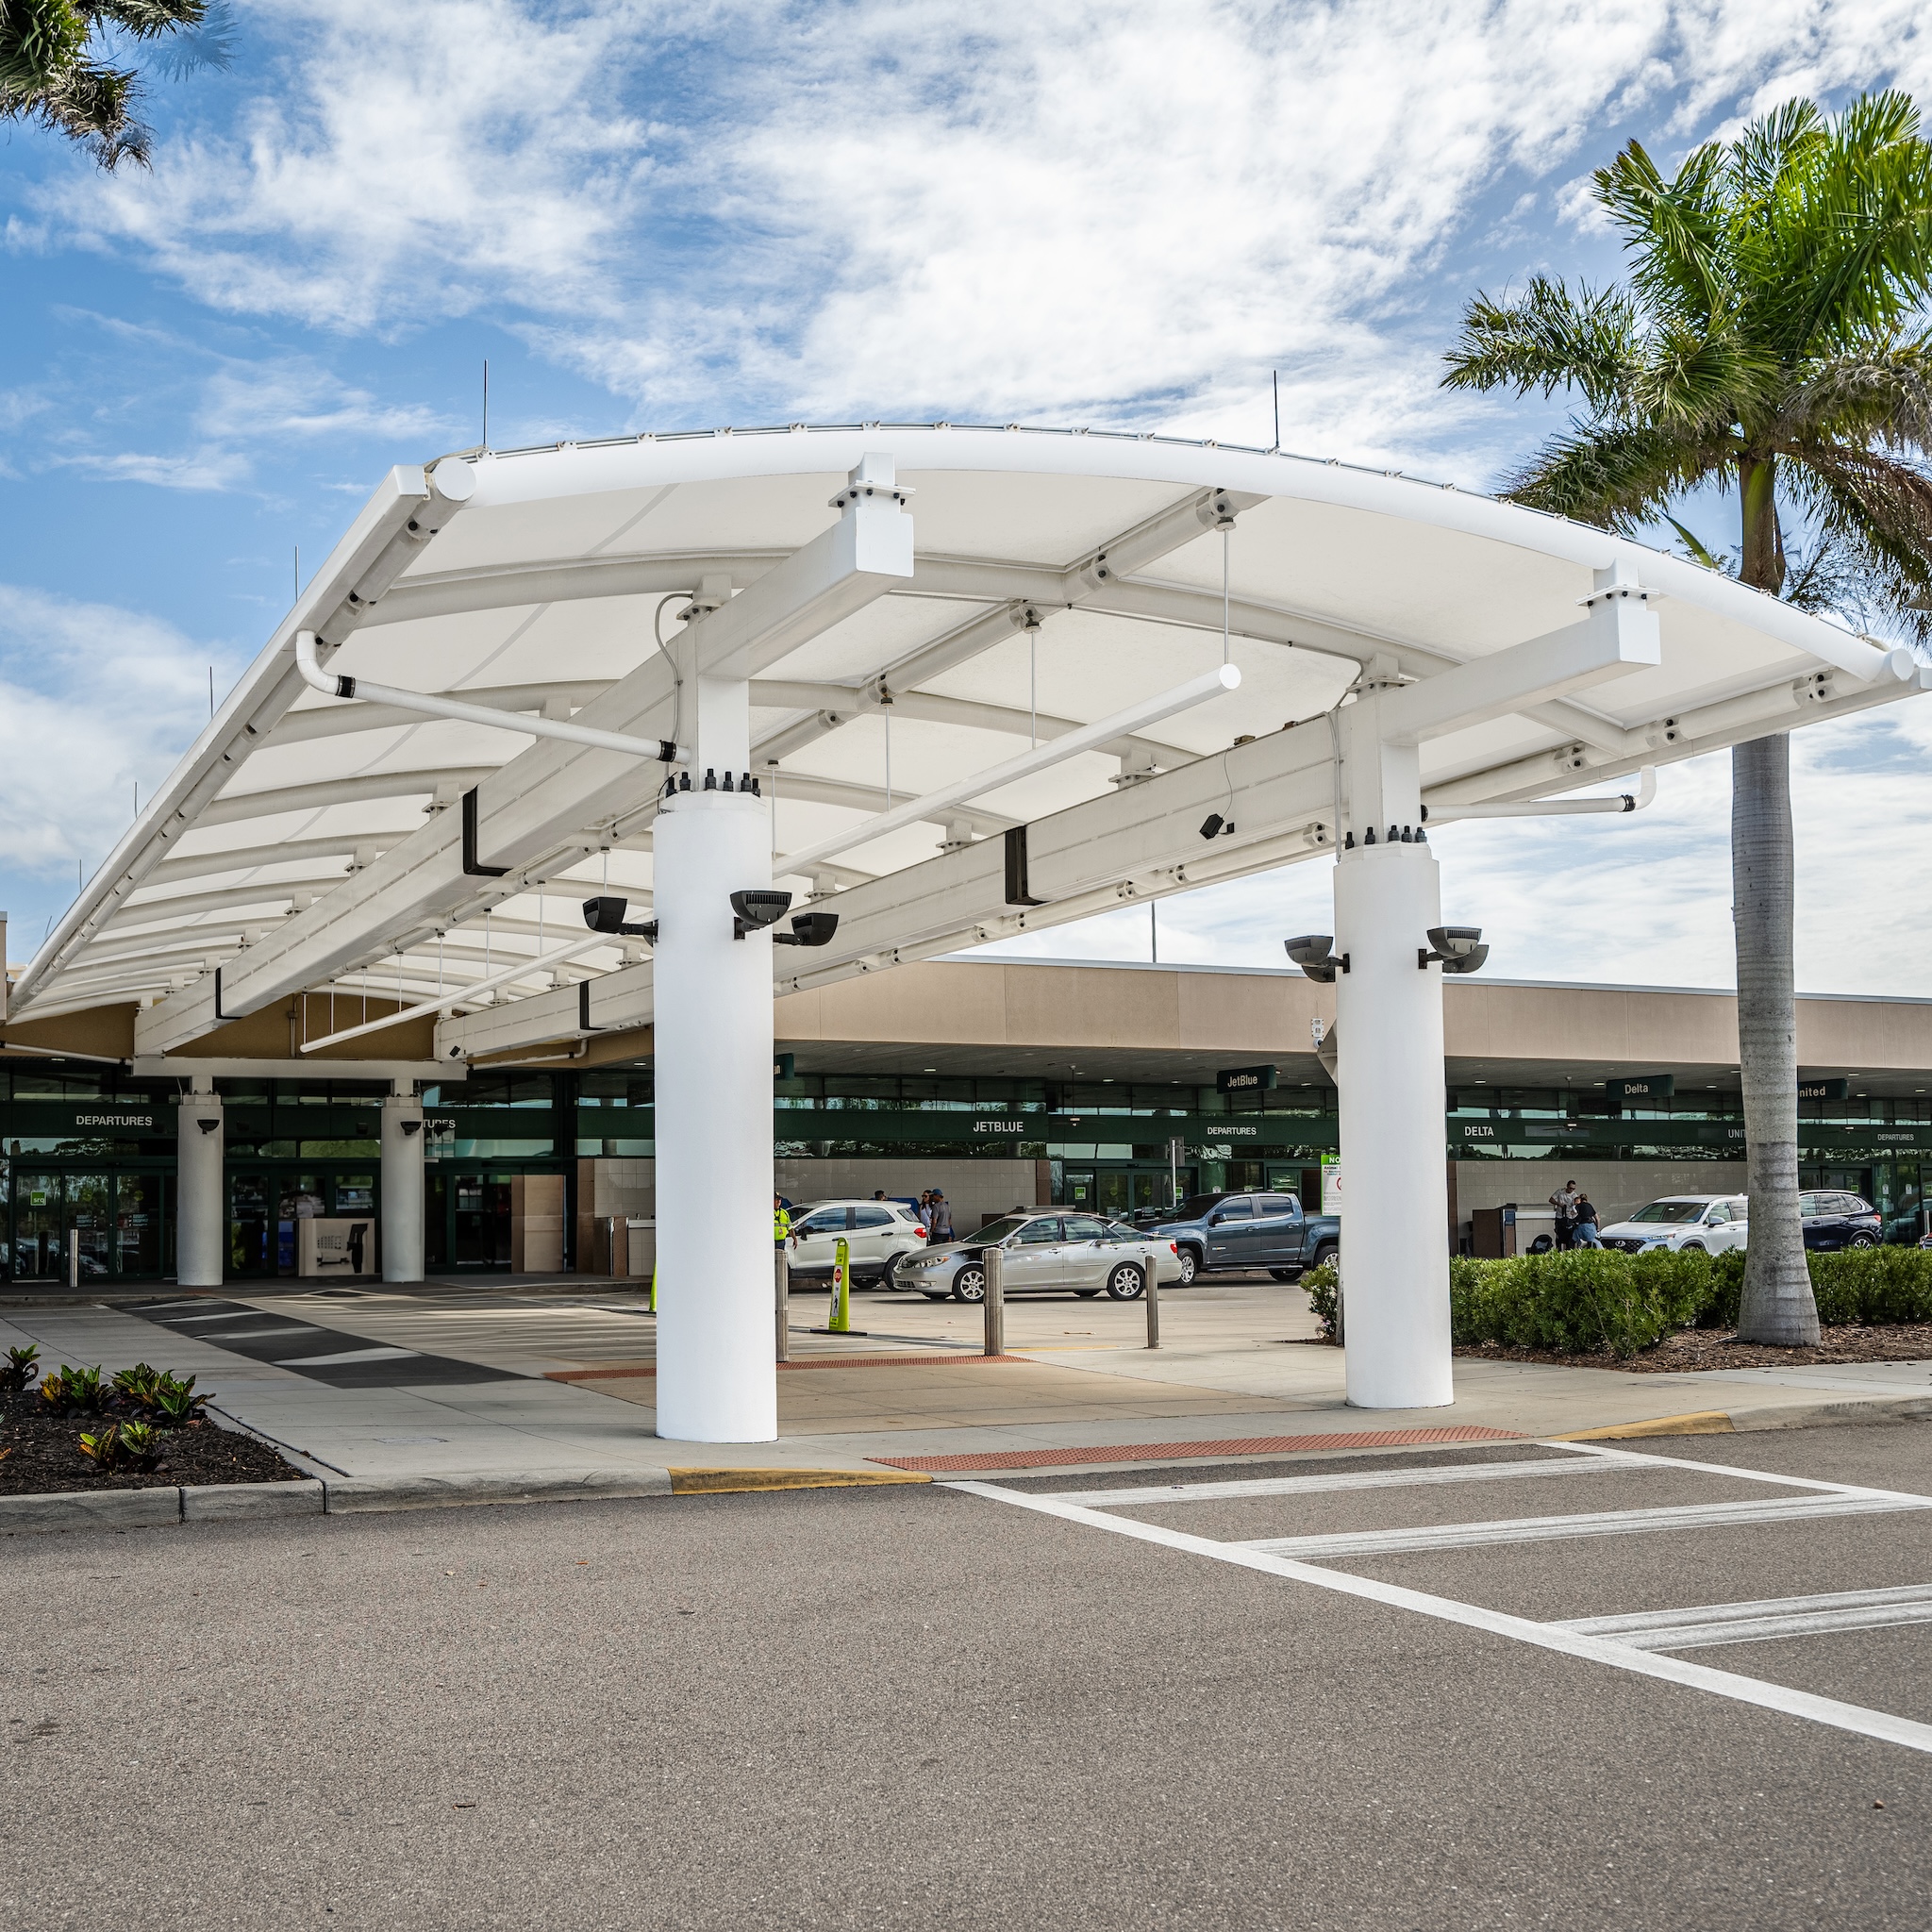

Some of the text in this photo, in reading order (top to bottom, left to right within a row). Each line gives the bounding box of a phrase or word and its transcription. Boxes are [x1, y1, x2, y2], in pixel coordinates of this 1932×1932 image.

[1227, 1074, 1257, 1088] JetBlue
[1624, 1084, 1649, 1094] Delta
[1799, 1086, 1826, 1098] nited
[75, 1115, 153, 1126] DEPARTURES
[973, 1121, 1024, 1132] JETBLUE
[1207, 1126, 1257, 1136] DEPARTURES
[1464, 1126, 1494, 1137] DELTA
[1877, 1133, 1915, 1141] DEPARTURES
